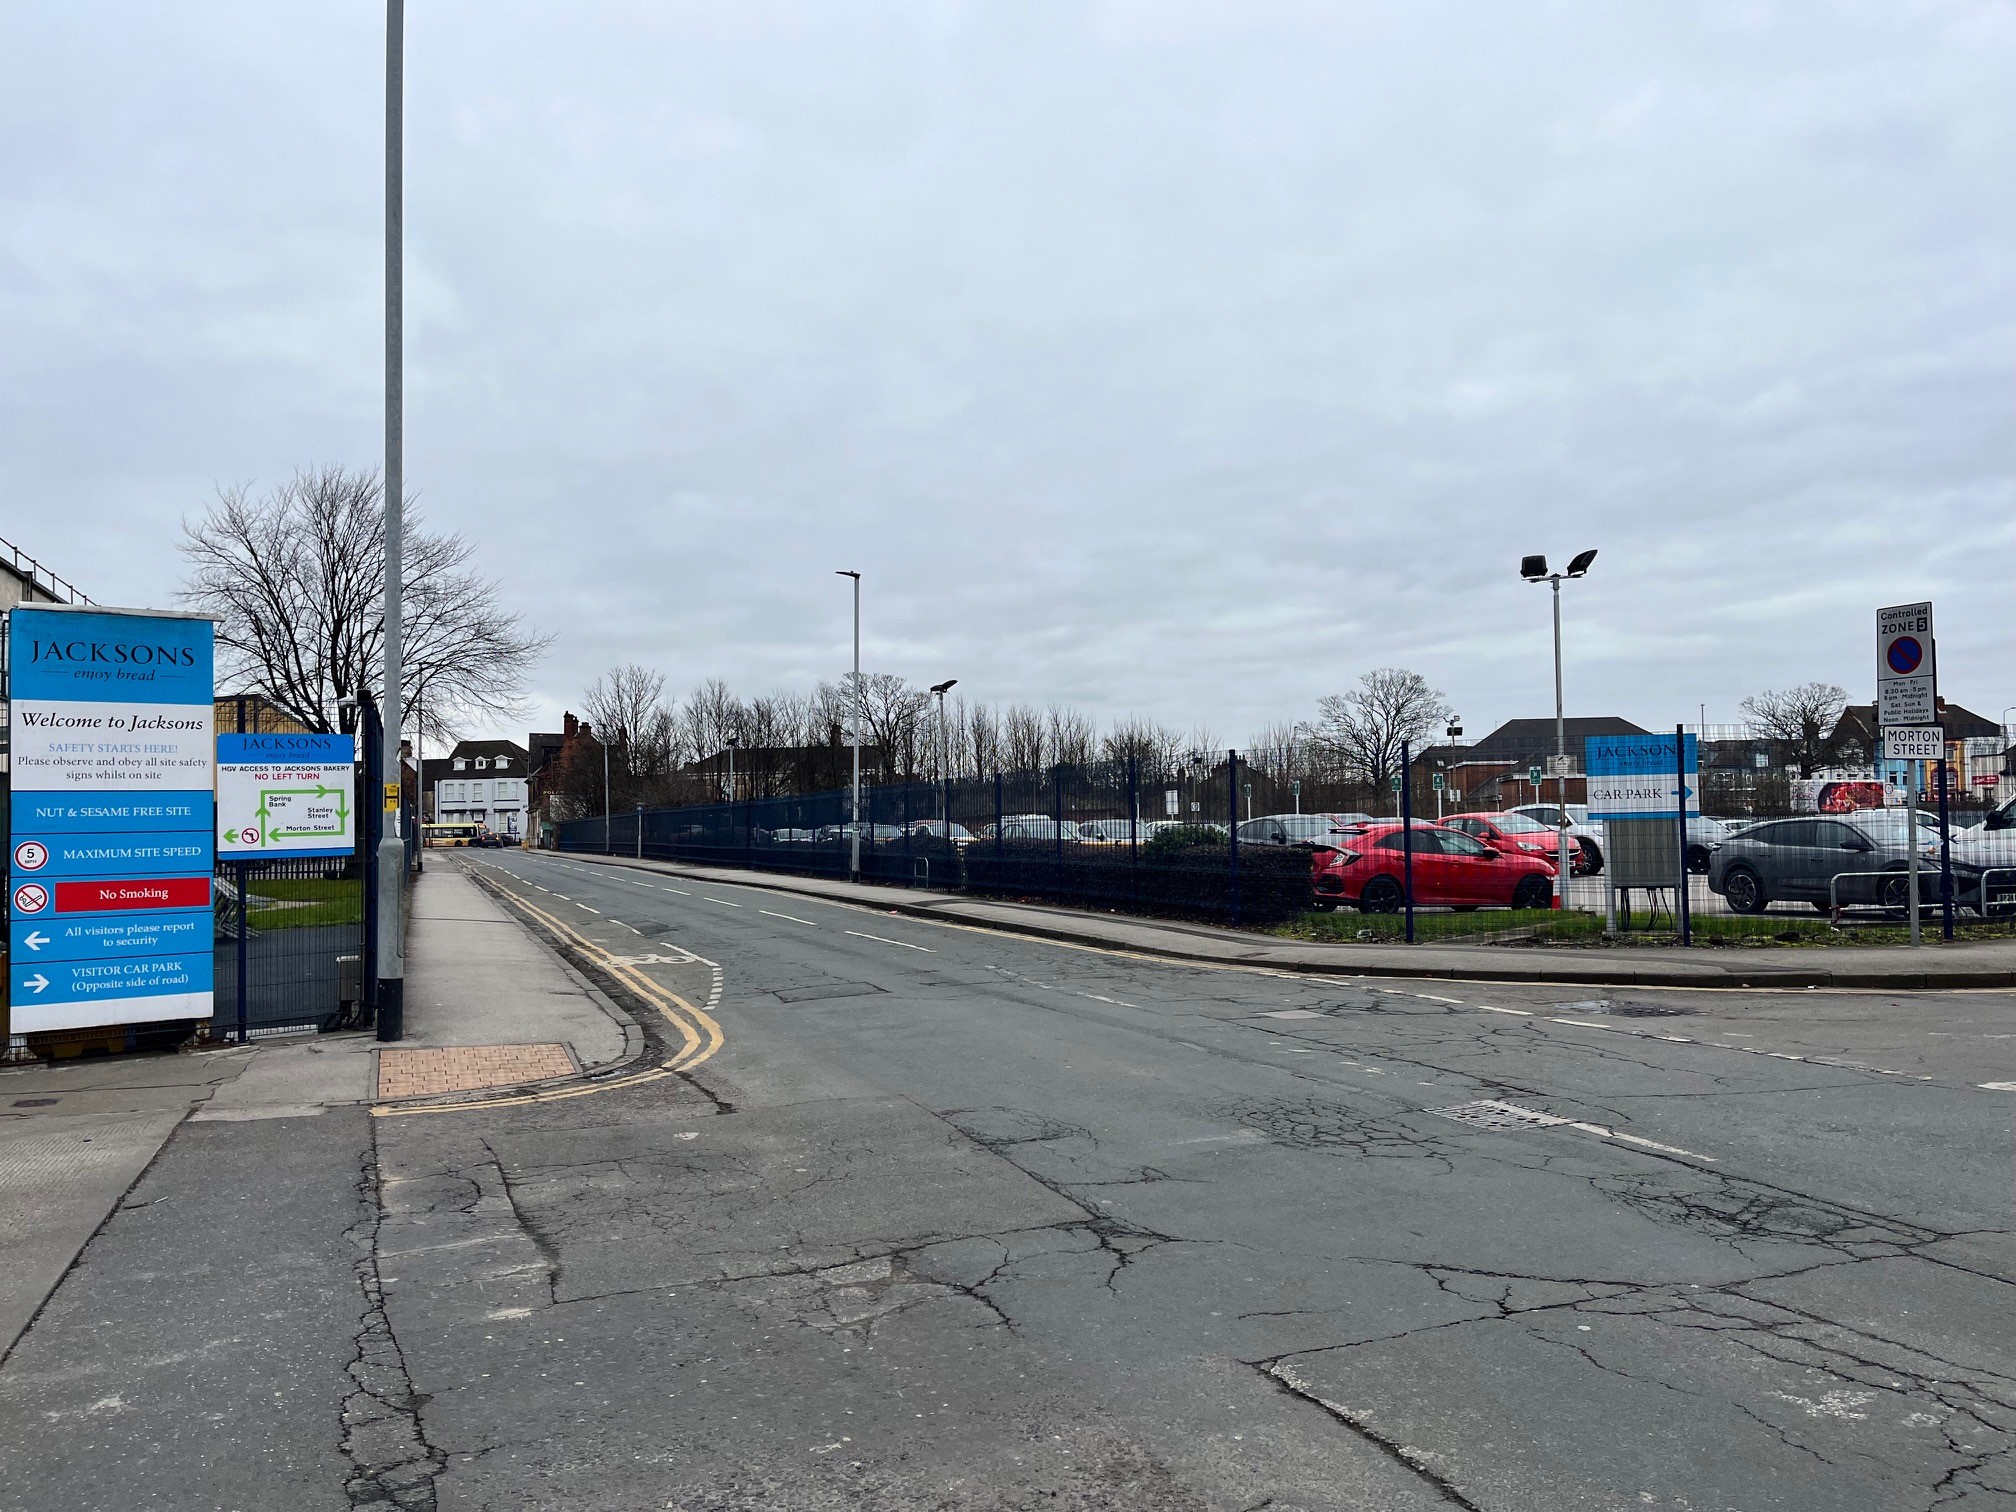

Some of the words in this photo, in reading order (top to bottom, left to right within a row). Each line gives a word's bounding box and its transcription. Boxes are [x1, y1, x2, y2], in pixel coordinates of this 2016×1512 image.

[1880, 607, 1928, 621] Controlled
[1881, 621, 1915, 635] ZONE
[1917, 618, 1927, 632] 5
[31, 640, 195, 667] JACKSONS
[74, 669, 112, 682] enjoy
[117, 669, 156, 681] bread
[21, 712, 102, 729] Welcome
[108, 715, 125, 729] to
[127, 715, 203, 732] Jacksons
[1888, 730, 1940, 742] MORTON
[49, 743, 94, 753] SAFETY
[97, 744, 141, 754] STARTS
[144, 744, 178, 754] HERE!
[243, 738, 331, 751] JACKSONS
[1893, 744, 1938, 755] STREET
[266, 752, 286, 760] enjoy
[1598, 744, 1685, 760] JACKSON
[18, 756, 50, 767] Please
[52, 757, 94, 767] observe
[96, 757, 116, 767] and
[118, 757, 142, 770] obey
[145, 758, 157, 767] all
[159, 758, 177, 767] site
[179, 758, 207, 769] safety
[66, 771, 93, 782] signs
[95, 770, 126, 780] whilst
[144, 771, 162, 780] site
[1593, 789, 1623, 800] CAR
[1626, 788, 1662, 800] PARK
[36, 808, 64, 818] NUT
[67, 808, 77, 818] &
[80, 807, 130, 817] SESAME
[133, 807, 163, 817] FREE
[166, 806, 191, 816] SITE
[26, 848, 35, 859] 5
[63, 848, 132, 860] MAXIMUM
[134, 847, 160, 857] SITE
[163, 846, 201, 857] SPEED
[99, 889, 117, 900] No
[119, 888, 169, 901] Smoking
[65, 926, 82, 937] All
[84, 925, 124, 937] visitors
[127, 923, 160, 938] please
[163, 922, 195, 934] report
[103, 938, 114, 947] to
[116, 935, 158, 948] security
[72, 965, 121, 978] VISITOR
[124, 963, 149, 975] CAR
[152, 962, 182, 973] PARK
[71, 978, 123, 993] (Opposite
[126, 976, 146, 987] side
[149, 975, 160, 986] of
[162, 974, 189, 985] road)
